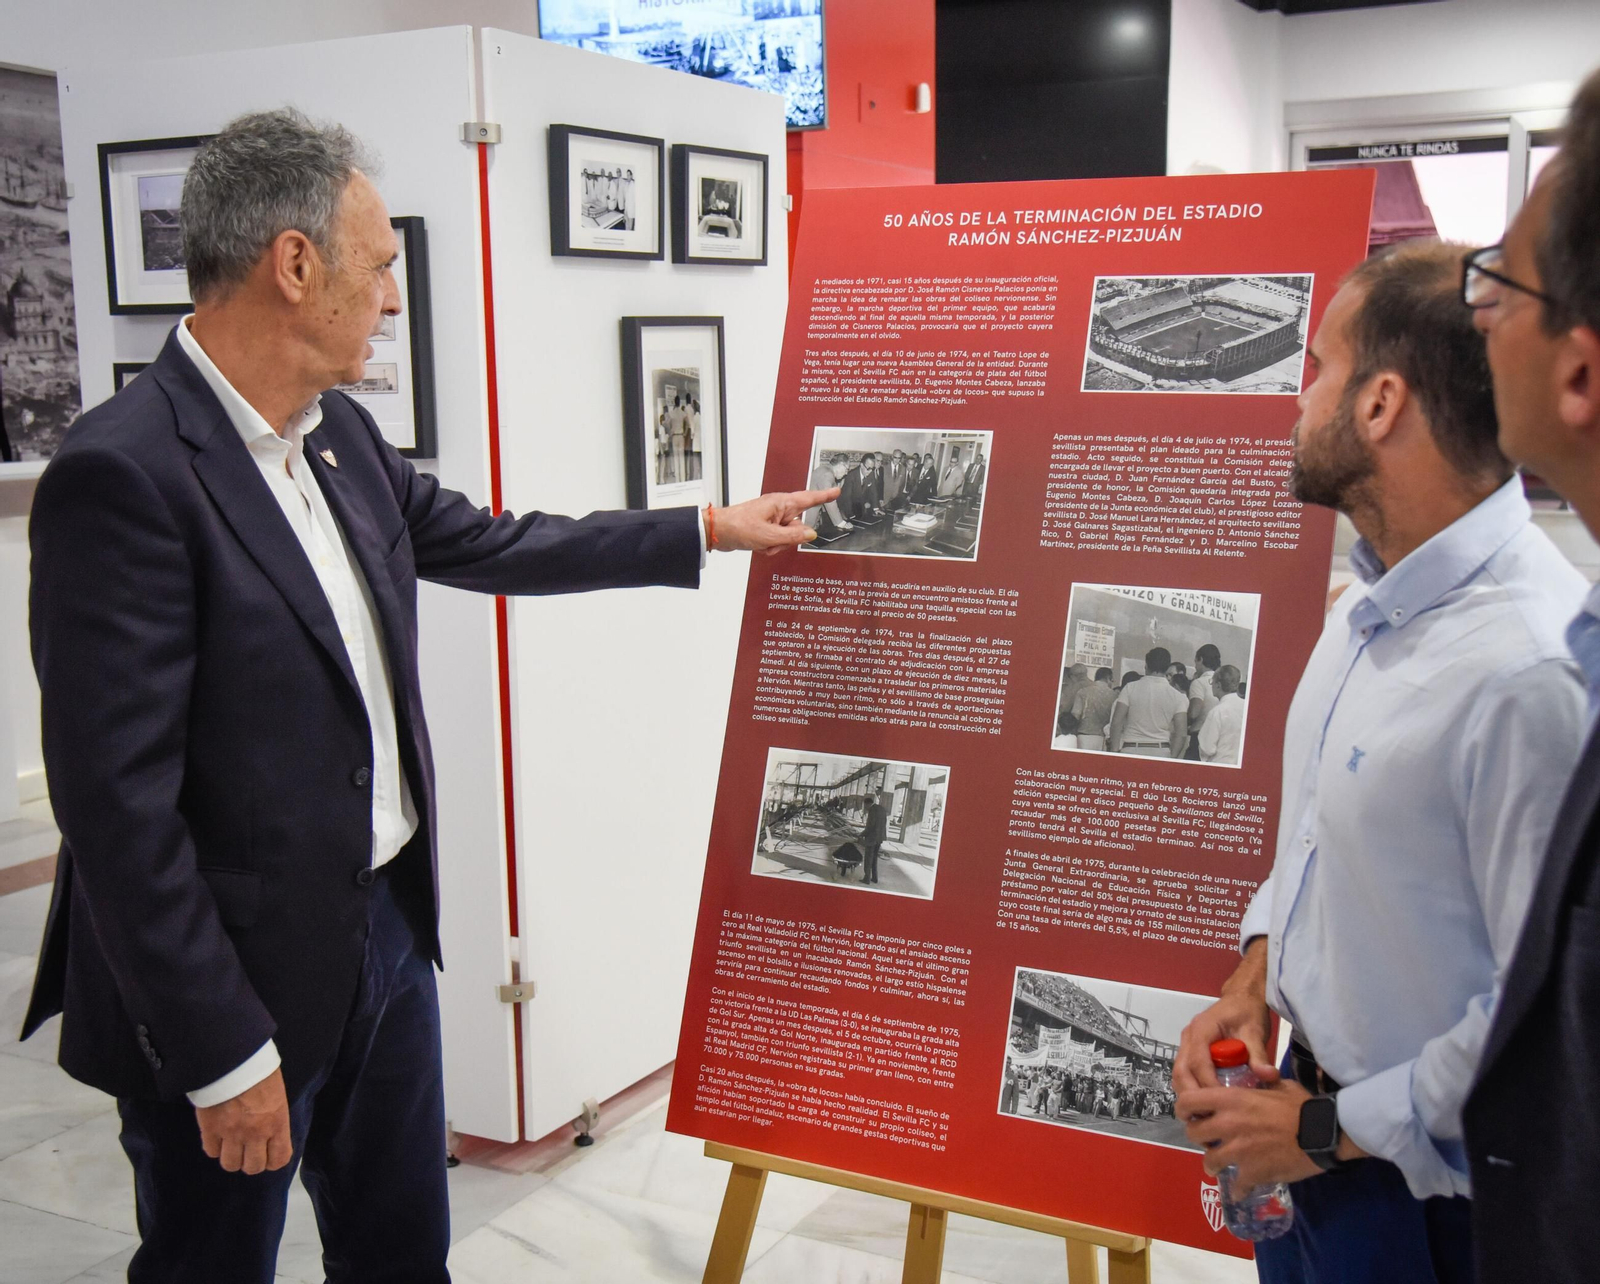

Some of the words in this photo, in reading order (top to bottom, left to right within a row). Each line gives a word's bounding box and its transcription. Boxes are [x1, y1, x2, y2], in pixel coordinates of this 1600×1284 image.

[1358, 144, 1398, 158] NUNCA
[1400, 144, 1414, 156] TE
[1416, 141, 1459, 155] RINDAS
[883, 214, 902, 227] 50
[908, 211, 953, 226] AÑOS
[959, 211, 981, 225] DE
[986, 211, 1006, 224] LA
[1015, 206, 1136, 224] TERMINACIÓN
[1142, 206, 1175, 220] DEL
[1183, 203, 1262, 219] ESTADIO
[948, 230, 1010, 246] RAMÓN
[1016, 227, 1182, 244] SÁNCHEZ-PIZJUÁN
[900, 313, 926, 322] aquella
[956, 313, 997, 321] temporada,
[1019, 313, 1054, 321] posterior
[924, 378, 953, 387] Eugenio
[984, 378, 1013, 387] Cabeza,
[908, 396, 967, 405] Sánchez-Pizjuán.
[1040, 530, 1059, 538] Rico,
[1079, 532, 1108, 540] Gabriel
[1114, 533, 1135, 542] Rojas
[1141, 534, 1184, 544] Fernández
[1215, 538, 1257, 547] Marcelino
[1263, 540, 1298, 549] Escobar
[1073, 522, 1108, 530] Galnares
[1111, 523, 1162, 533] Sagastizabal,
[1176, 526, 1214, 535] ingeniero
[1228, 528, 1261, 537] Antonio
[1264, 530, 1300, 539] Sánchez
[1160, 594, 1166, 604] Y
[1171, 598, 1204, 614] GRADA
[1210, 608, 1234, 623] ALTA
[764, 630, 805, 640] establecido,
[817, 633, 850, 642] Comisión
[852, 636, 885, 646] delegada
[887, 639, 912, 647] recibía
[929, 642, 966, 652] diferentes
[969, 647, 1011, 655] propuestas
[758, 667, 788, 675] empresa
[789, 670, 834, 679] constructora
[835, 674, 876, 683] comenzaba
[884, 678, 916, 686] trasladar
[918, 680, 930, 688] los
[931, 682, 964, 691] primeros
[966, 686, 1006, 695] materiales
[1010, 809, 1045, 818] recaudar
[1087, 817, 1120, 828] 100.000
[1124, 823, 1156, 832] pesetas
[1204, 832, 1243, 842] concepto
[1249, 835, 1262, 844] (Ya
[1013, 849, 1038, 859] finales
[1051, 855, 1070, 863] abril
[1085, 858, 1106, 869] 1975,
[1108, 862, 1140, 872] durante
[1141, 865, 1149, 873] la
[1151, 868, 1200, 880] celebración
[1201, 873, 1212, 882] de
[1231, 879, 1257, 887] nueva
[719, 938, 742, 948] triunfo
[746, 944, 776, 954] sevillista
[805, 952, 842, 965] inacabado
[846, 959, 871, 969] Ramón
[874, 963, 936, 980] Sánchez-Pizjuán.
[940, 974, 956, 983] Con
[714, 968, 734, 977] obras
[746, 974, 788, 986] cerramiento
[789, 980, 801, 988] del
[802, 983, 831, 993] estadio.
[703, 1045, 727, 1055] 70.000
[735, 1050, 759, 1061] 75.000
[760, 1057, 792, 1068] personas
[818, 1068, 845, 1078] gradas.
[705, 1025, 738, 1038] Espanyol,
[740, 1032, 769, 1043] también
[785, 1040, 810, 1051] triunfo
[811, 1046, 843, 1057] sevillista
[845, 1050, 863, 1061] (2-1).
[866, 1054, 875, 1063] Ya
[888, 1060, 929, 1074] noviembre,
[932, 1067, 955, 1078] frente
[708, 1107, 736, 1118] estarían
[752, 1115, 773, 1126] llegar.
